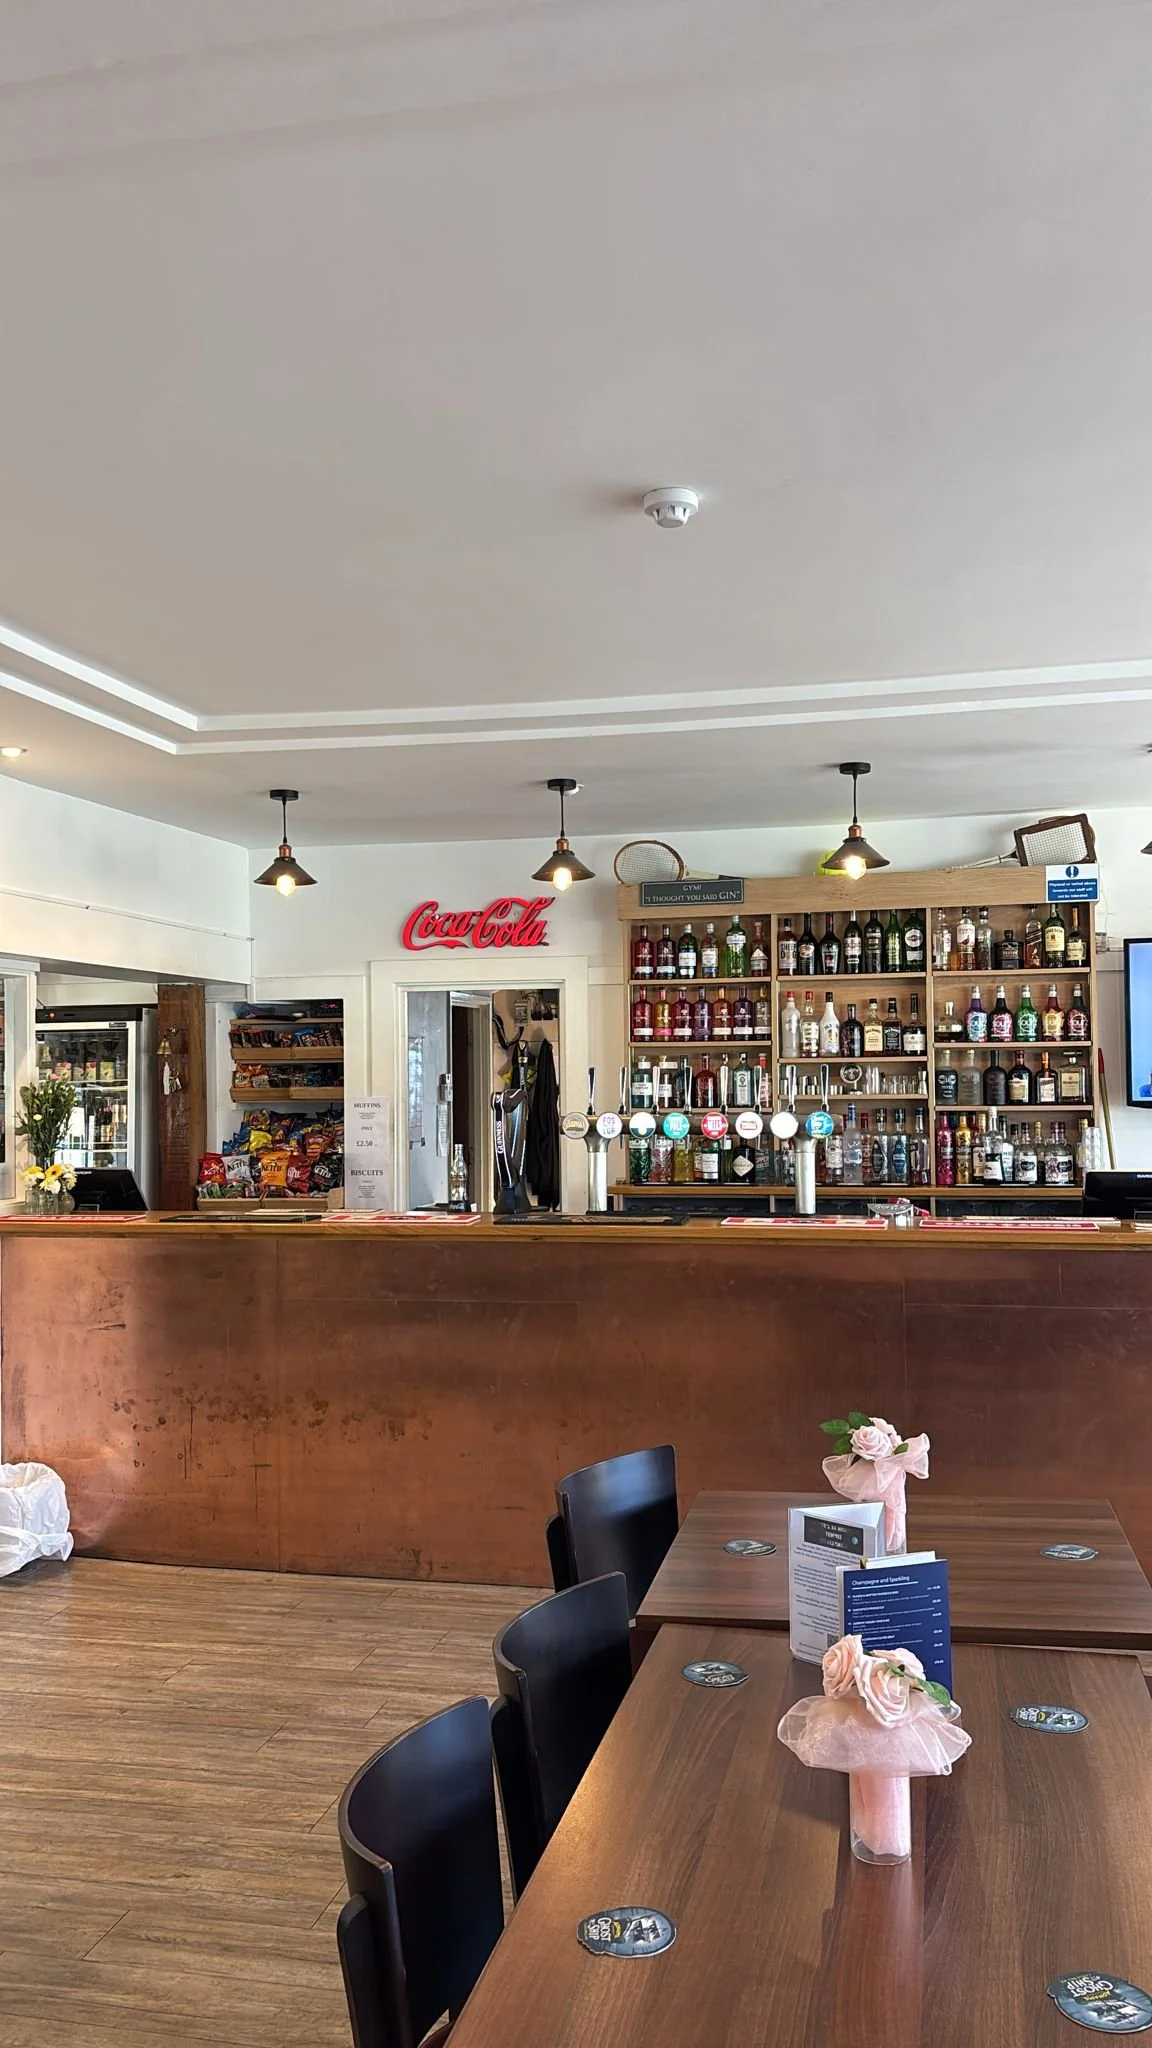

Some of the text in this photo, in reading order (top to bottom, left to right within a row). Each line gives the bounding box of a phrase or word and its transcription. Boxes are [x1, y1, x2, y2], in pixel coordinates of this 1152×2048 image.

[686, 893, 700, 901] YOU
[718, 890, 740, 900] GIN"
[402, 896, 556, 951] Coca-Cola
[496, 1120, 505, 1154] GUINNESS
[852, 1577, 879, 1587] Champagne
[889, 1575, 910, 1583] Sparkling
[588, 1924, 600, 1941] SHIP
[598, 1917, 612, 1942] GHOST
[1066, 1976, 1090, 1990] SHIP
[1073, 1980, 1114, 1997] GHOST
